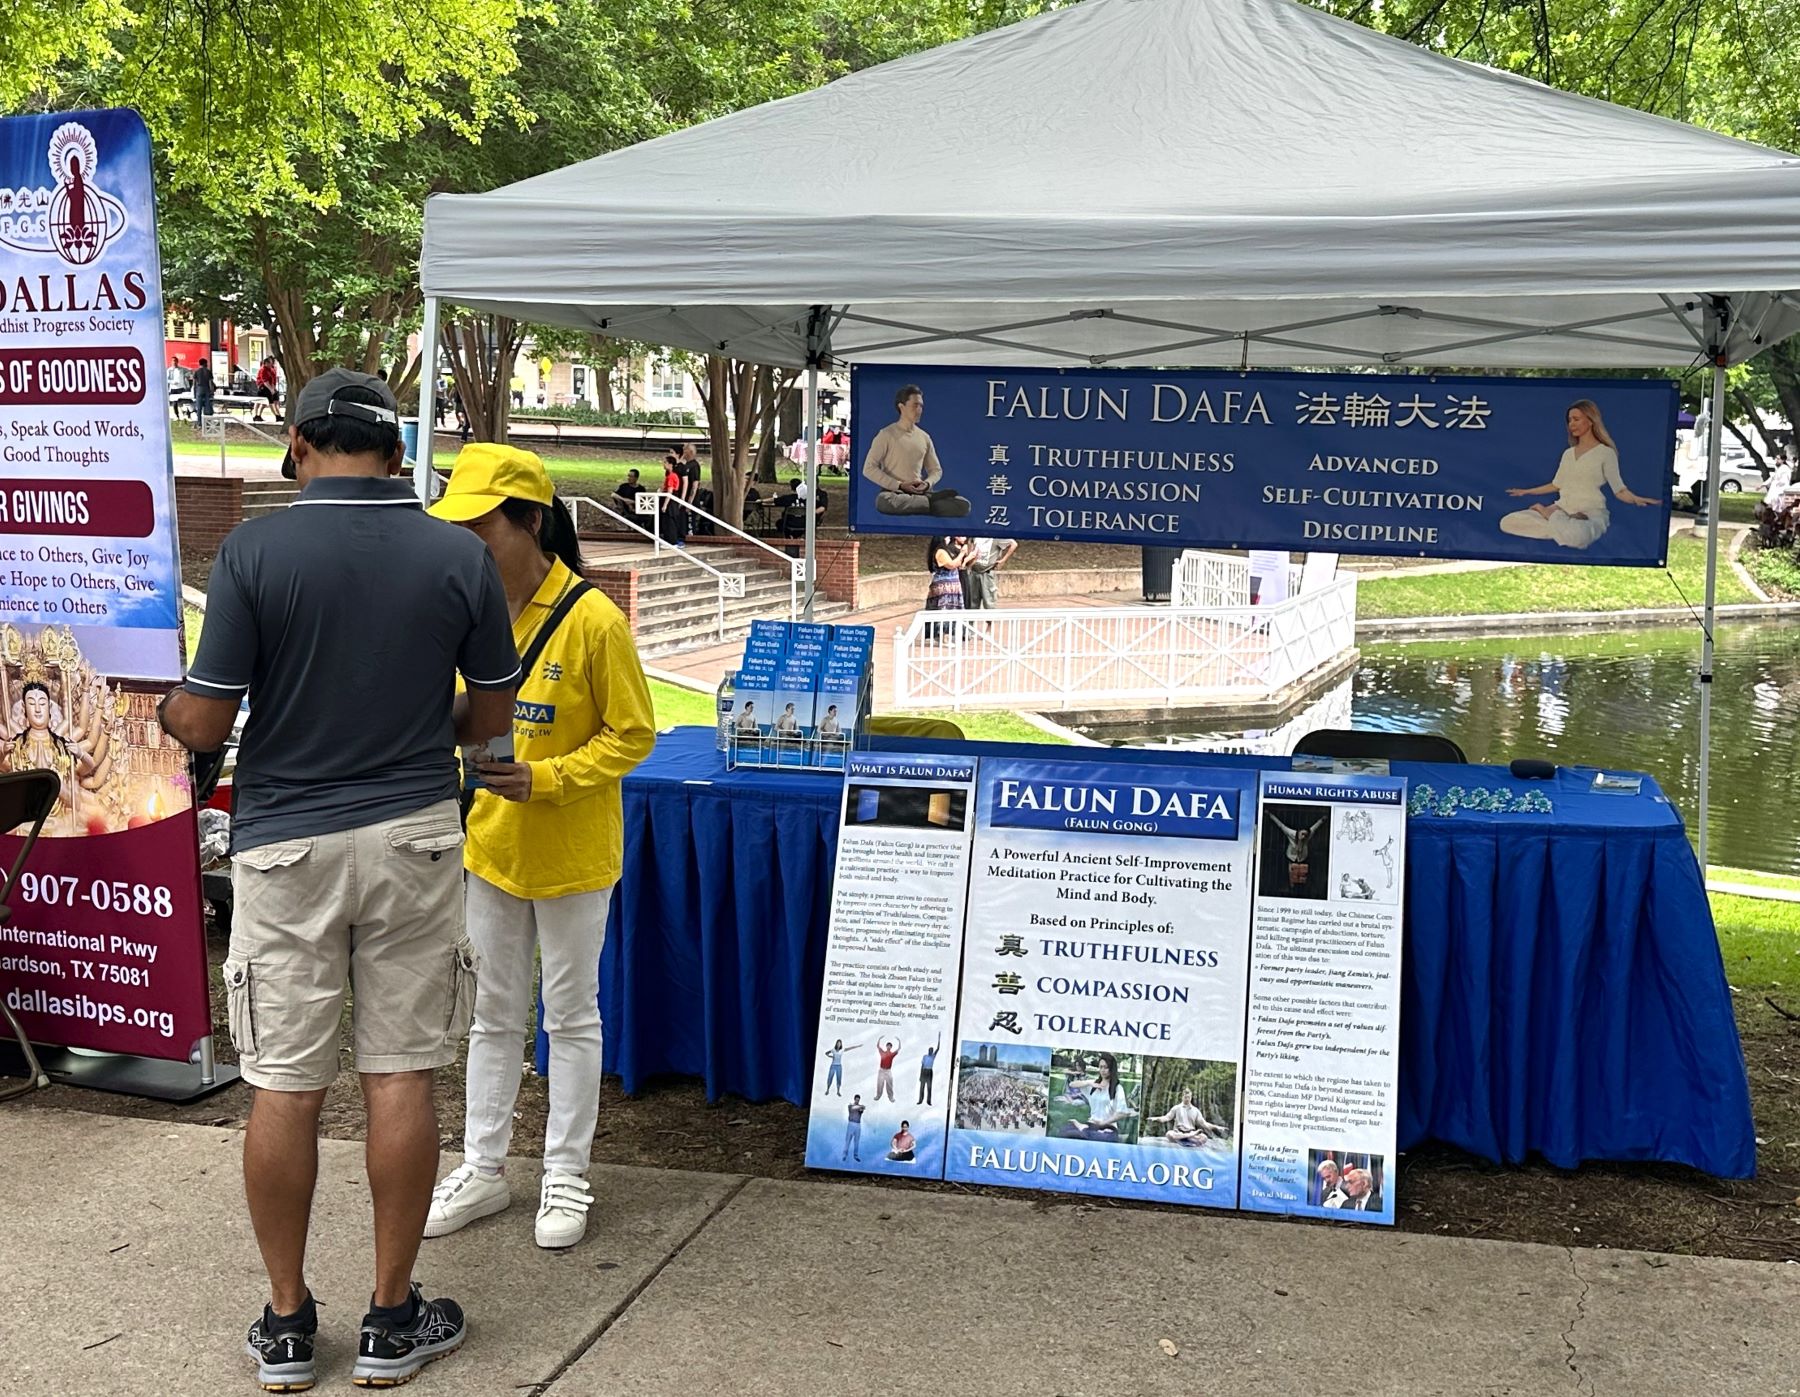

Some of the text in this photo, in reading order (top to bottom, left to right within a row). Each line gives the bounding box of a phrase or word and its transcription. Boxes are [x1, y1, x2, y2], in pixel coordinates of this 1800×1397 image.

[34, 316, 85, 336] Progress
[90, 316, 134, 335] Society
[10, 360, 32, 393] OF
[38, 358, 142, 393] GOODNESS
[985, 380, 1274, 425] FALUN DAFA
[1295, 392, 1491, 429] 法輪大法
[11, 420, 49, 442] Speak
[53, 420, 91, 437] Good
[95, 420, 144, 440] Words,
[3, 446, 109, 466] Good Thoughts
[988, 444, 1010, 465] 真
[1028, 445, 1235, 472] TRUTHFULNESS
[1307, 453, 1439, 476] ADVANCED
[986, 474, 1012, 496] 善
[1028, 476, 1201, 503] COMPASSION
[13, 490, 89, 524] GIVINGS
[1262, 485, 1484, 512] SELF-CULTIVATION
[985, 505, 1011, 526] 忍
[1027, 505, 1180, 533] TOLERANCE
[1303, 520, 1439, 544] DISCIPLINE
[21, 548, 34, 562] to
[39, 546, 88, 567] Others,
[92, 548, 122, 564] Give
[127, 549, 149, 569] Joy
[10, 571, 48, 591] Hope
[52, 574, 65, 587] to
[71, 572, 120, 592] Others,
[125, 574, 155, 591] Give
[43, 599, 57, 613] to
[62, 598, 107, 615] Others
[543, 661, 562, 681] 法
[851, 764, 971, 778] WHAT IS FALUN DAFA?
[998, 780, 1233, 820] FALUN DAFA
[1268, 785, 1398, 800] HUMAN RIGHTS ABUSE
[1065, 817, 1158, 833] (FALUN GONG)
[990, 848, 1232, 873] A Powerful Ancient Self-Improvement
[987, 865, 1232, 893] Meditation Practice for Cultivating the
[20, 872, 173, 918] 907-0588
[1056, 887, 1157, 905] Mind and Body.
[1030, 914, 1174, 934] Based on Principles of:
[111, 935, 157, 963] Pkwy
[994, 933, 1028, 958] 真
[1039, 939, 1219, 968] TRUTHFULNESS
[70, 960, 94, 981] TX
[99, 963, 150, 988] 75081
[991, 971, 1025, 996] 善
[1036, 976, 1189, 1004] COMPASSION
[7, 987, 174, 1037] dallasibps.org
[989, 1010, 1023, 1035] 忍
[1034, 1013, 1171, 1041] TOLERANCE
[969, 1146, 1214, 1190] FALUNDAFA.ORG
